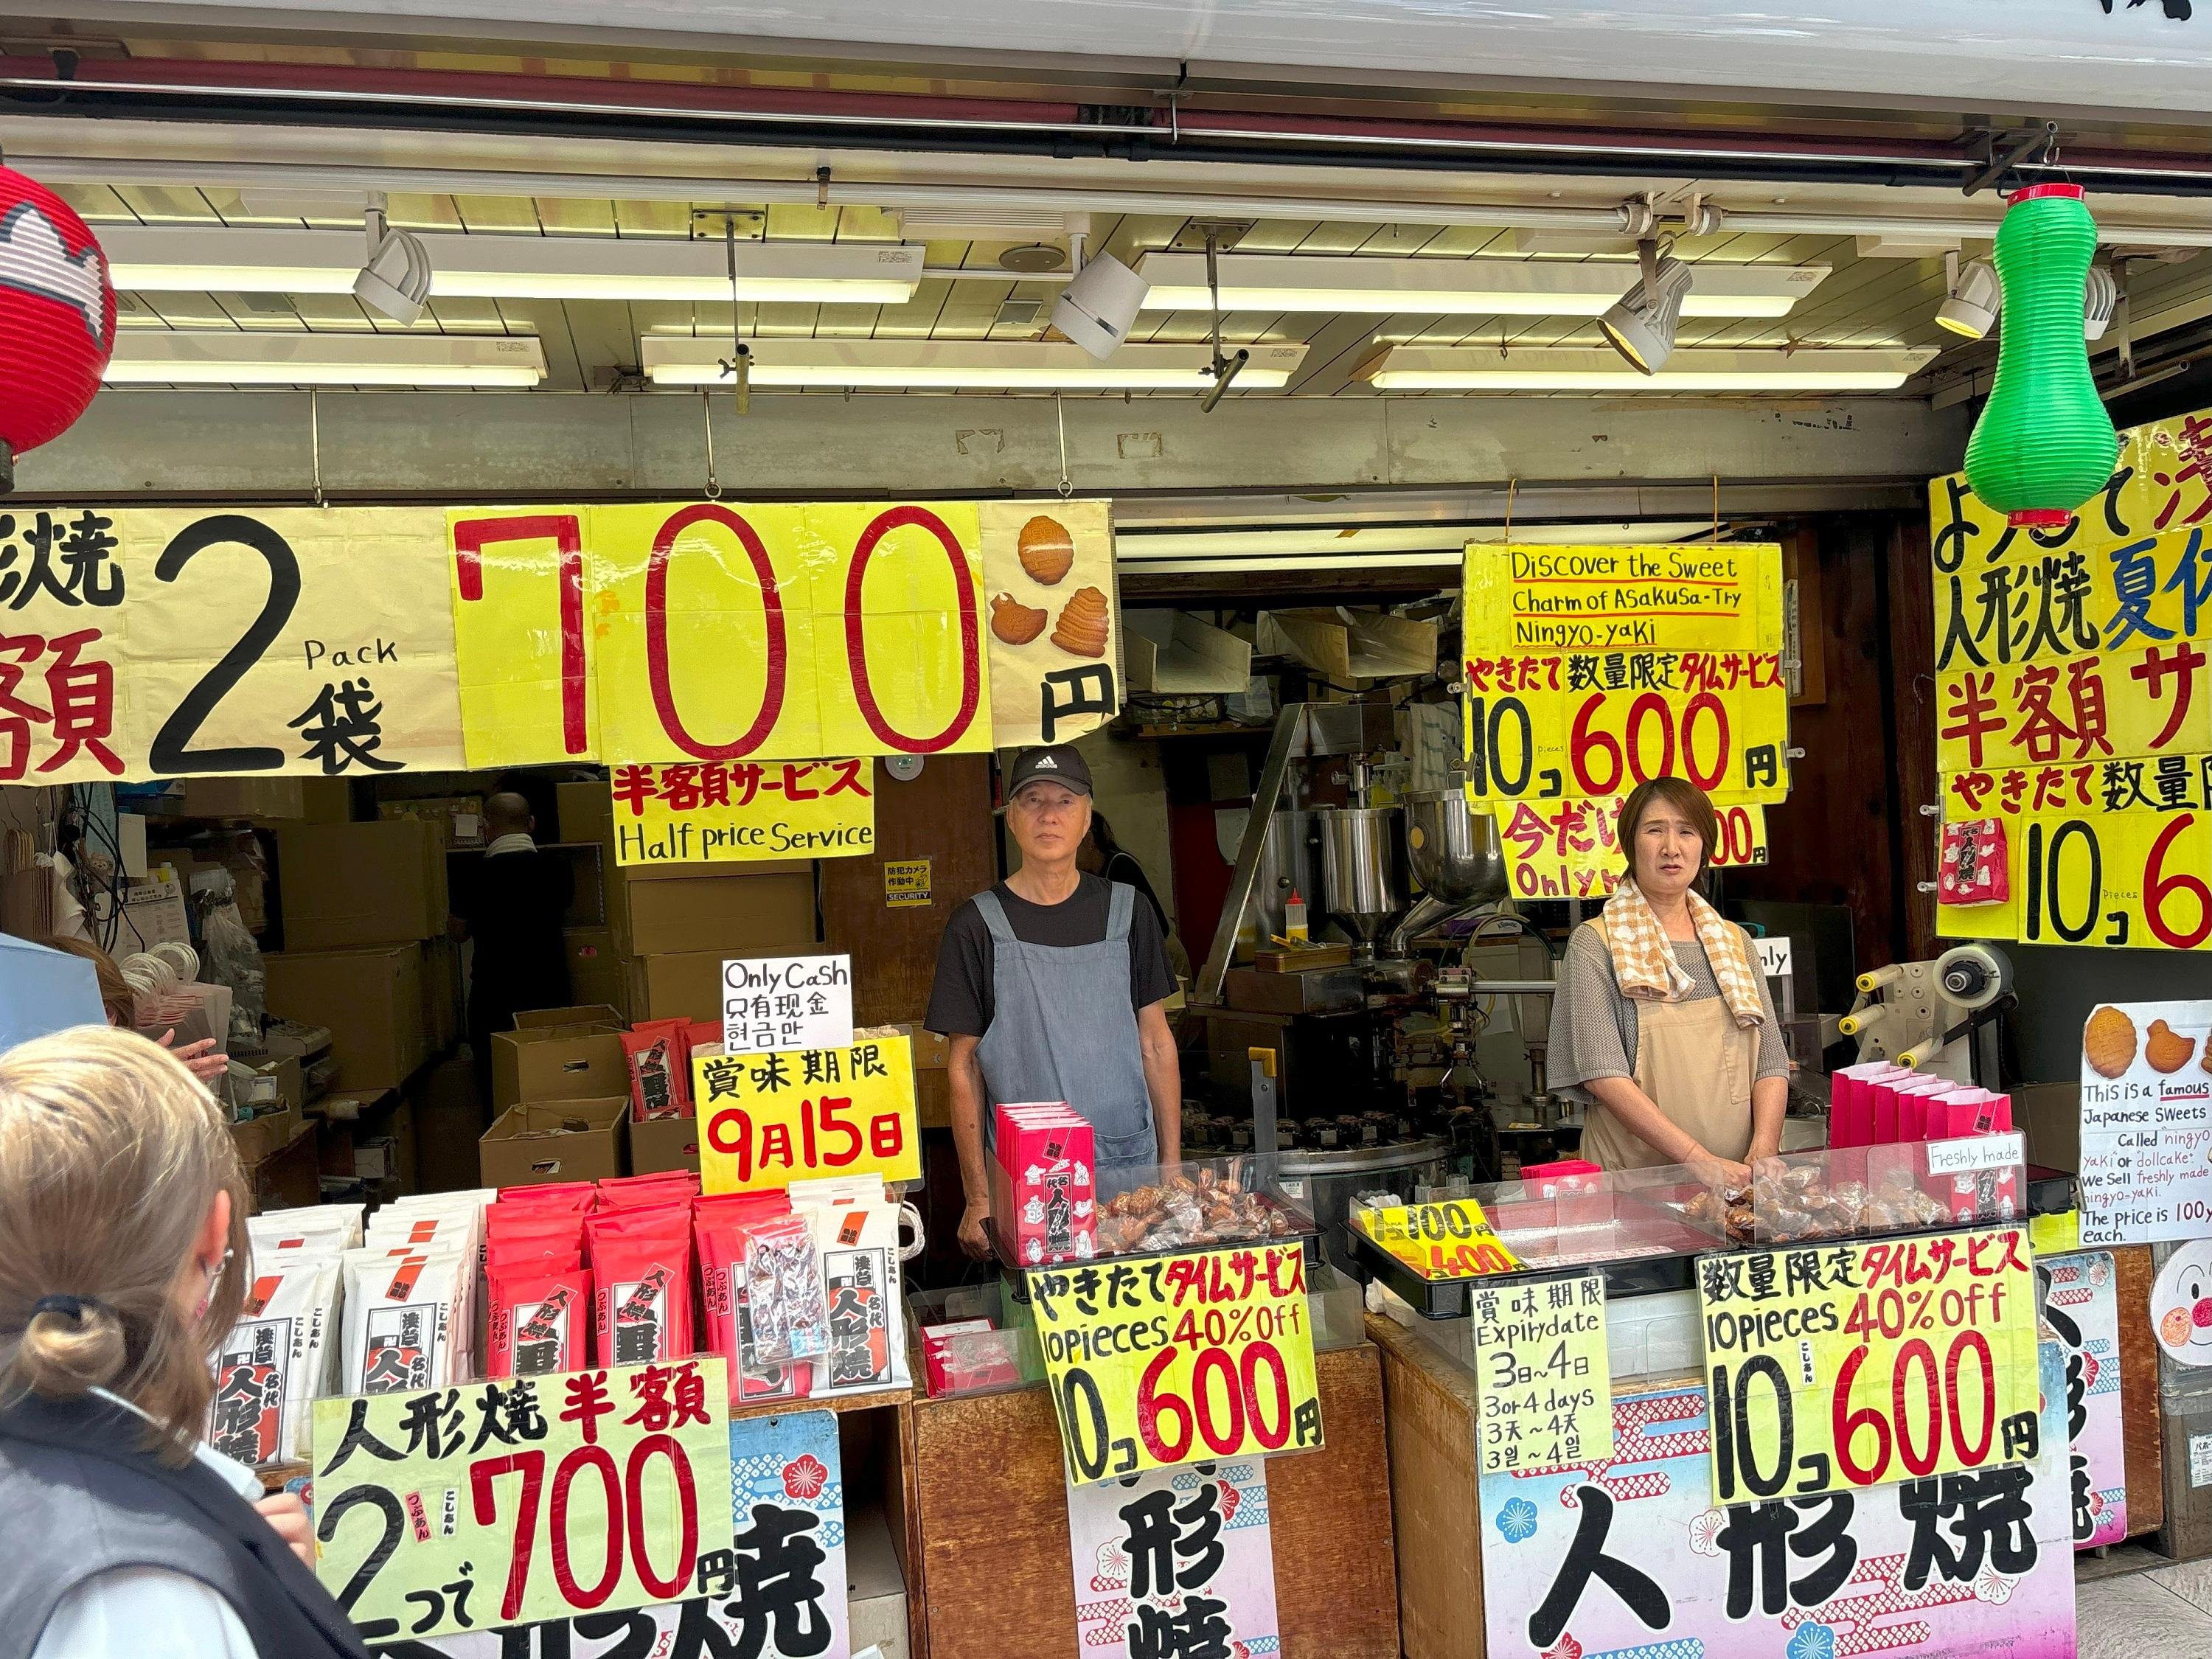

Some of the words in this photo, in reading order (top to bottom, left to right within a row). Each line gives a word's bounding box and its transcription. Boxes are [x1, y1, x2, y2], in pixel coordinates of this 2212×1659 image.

[1628, 553, 1662, 577] the
[1668, 552, 1738, 578] Sweet
[1513, 588, 1582, 613] Charm
[1586, 591, 1608, 611] of
[453, 504, 1116, 761] 700円
[304, 638, 398, 669] Pack
[1466, 656, 1562, 692] やきたて
[1568, 652, 1680, 692] 数量限定
[1679, 652, 1785, 692] タイムサービス
[1571, 692, 1778, 796] 600円
[613, 759, 872, 816] 半額サービス
[1951, 764, 2095, 812] やきたて
[619, 822, 694, 860] Half
[703, 822, 765, 860] price
[770, 821, 873, 852] Service
[1710, 807, 1766, 866] 00円
[887, 865, 927, 875] 防犯カメラ
[888, 877, 914, 886] 作動中
[888, 892, 928, 900] SECURITY
[726, 962, 781, 994] Only
[1761, 945, 1787, 974] nly
[726, 992, 829, 1020] 只有现金
[727, 1022, 803, 1051] 현금만
[703, 1045, 888, 1102] 賞味期限
[2142, 1085, 2153, 1097] a
[2084, 1108, 2149, 1127] Japanese
[707, 1096, 903, 1182] 9月15日
[1930, 1146, 1978, 1170] Freshly
[1983, 1143, 2020, 1163] made
[2118, 1157, 2132, 1168] or
[2137, 1170, 2174, 1186] freshly
[2180, 1165, 2209, 1179] made
[2084, 1211, 2110, 1226] The
[2115, 1209, 2152, 1229] price
[2157, 1208, 2168, 1222] is
[2084, 1229, 2126, 1242] each.
[1032, 1262, 1166, 1322] やきたて
[1164, 1246, 1307, 1308] タイムサービス
[1703, 1248, 1864, 1306] 数量限定
[1860, 1230, 2032, 1289] タイムサービス
[715, 1271, 728, 1313] つぶあん
[1476, 1279, 1602, 1324] 賞味期限
[597, 1292, 608, 1332] つぶあん
[320, 1380, 549, 1478] 人形焼
[559, 1360, 712, 1444] 半額
[1137, 1341, 1324, 1463] 600円
[1544, 1388, 1596, 1413] days
[1833, 1330, 2039, 1486] 600円
[408, 1494, 429, 1540] つぶあん
[470, 1433, 735, 1621] 700円
